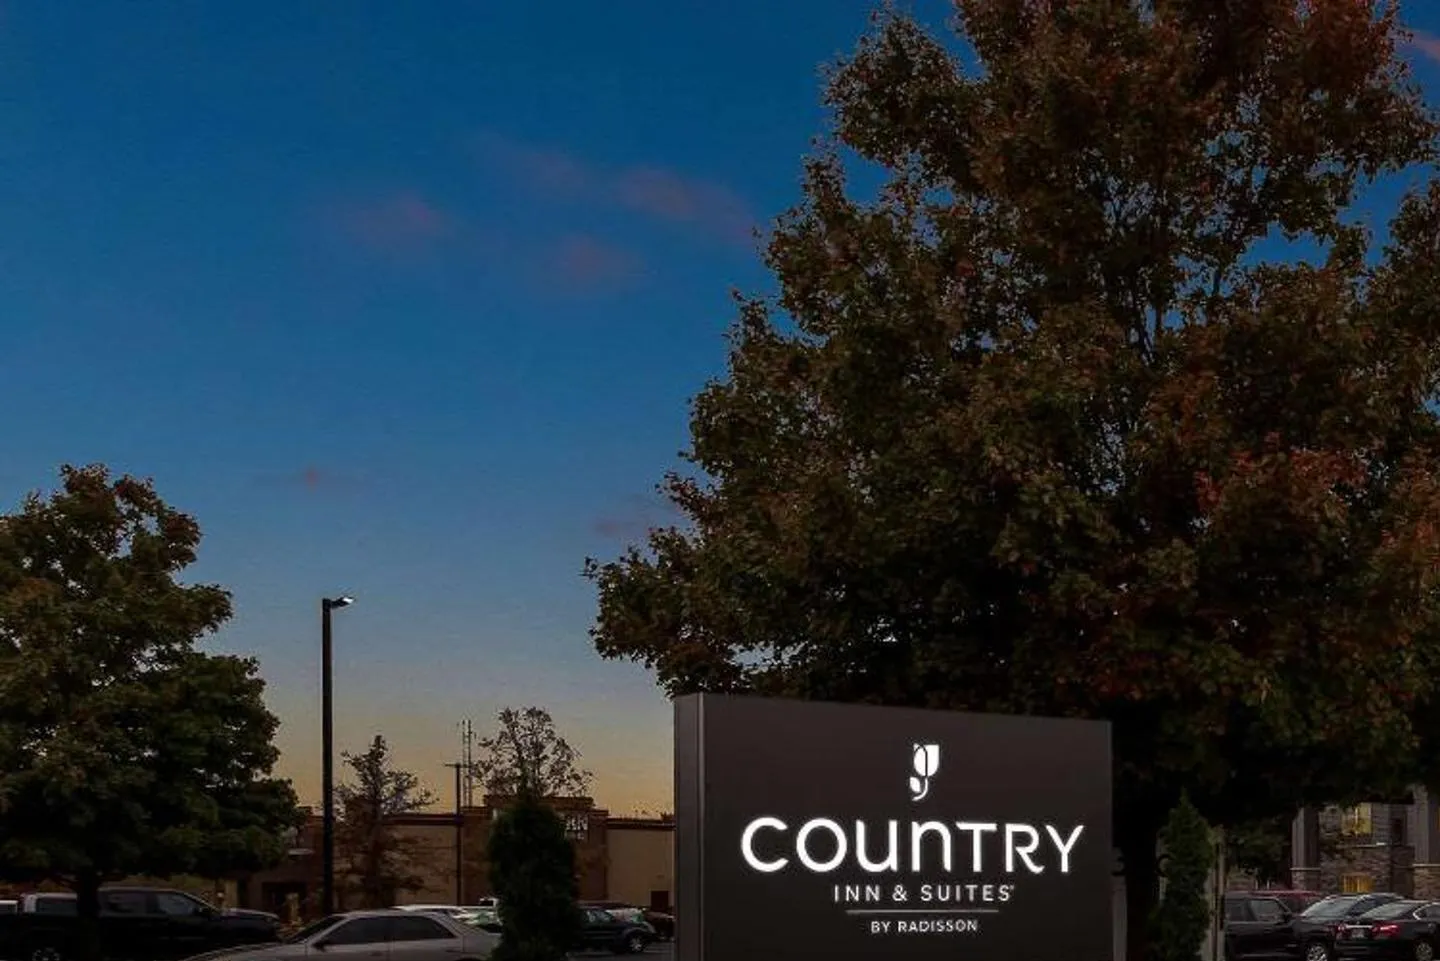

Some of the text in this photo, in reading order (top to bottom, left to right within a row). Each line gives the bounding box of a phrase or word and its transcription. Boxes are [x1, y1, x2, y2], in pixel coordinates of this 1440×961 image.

[740, 816, 1085, 874] COUNTRY
[834, 884, 1014, 903] INN & SUITES
[870, 918, 978, 934] BY RADISSON
